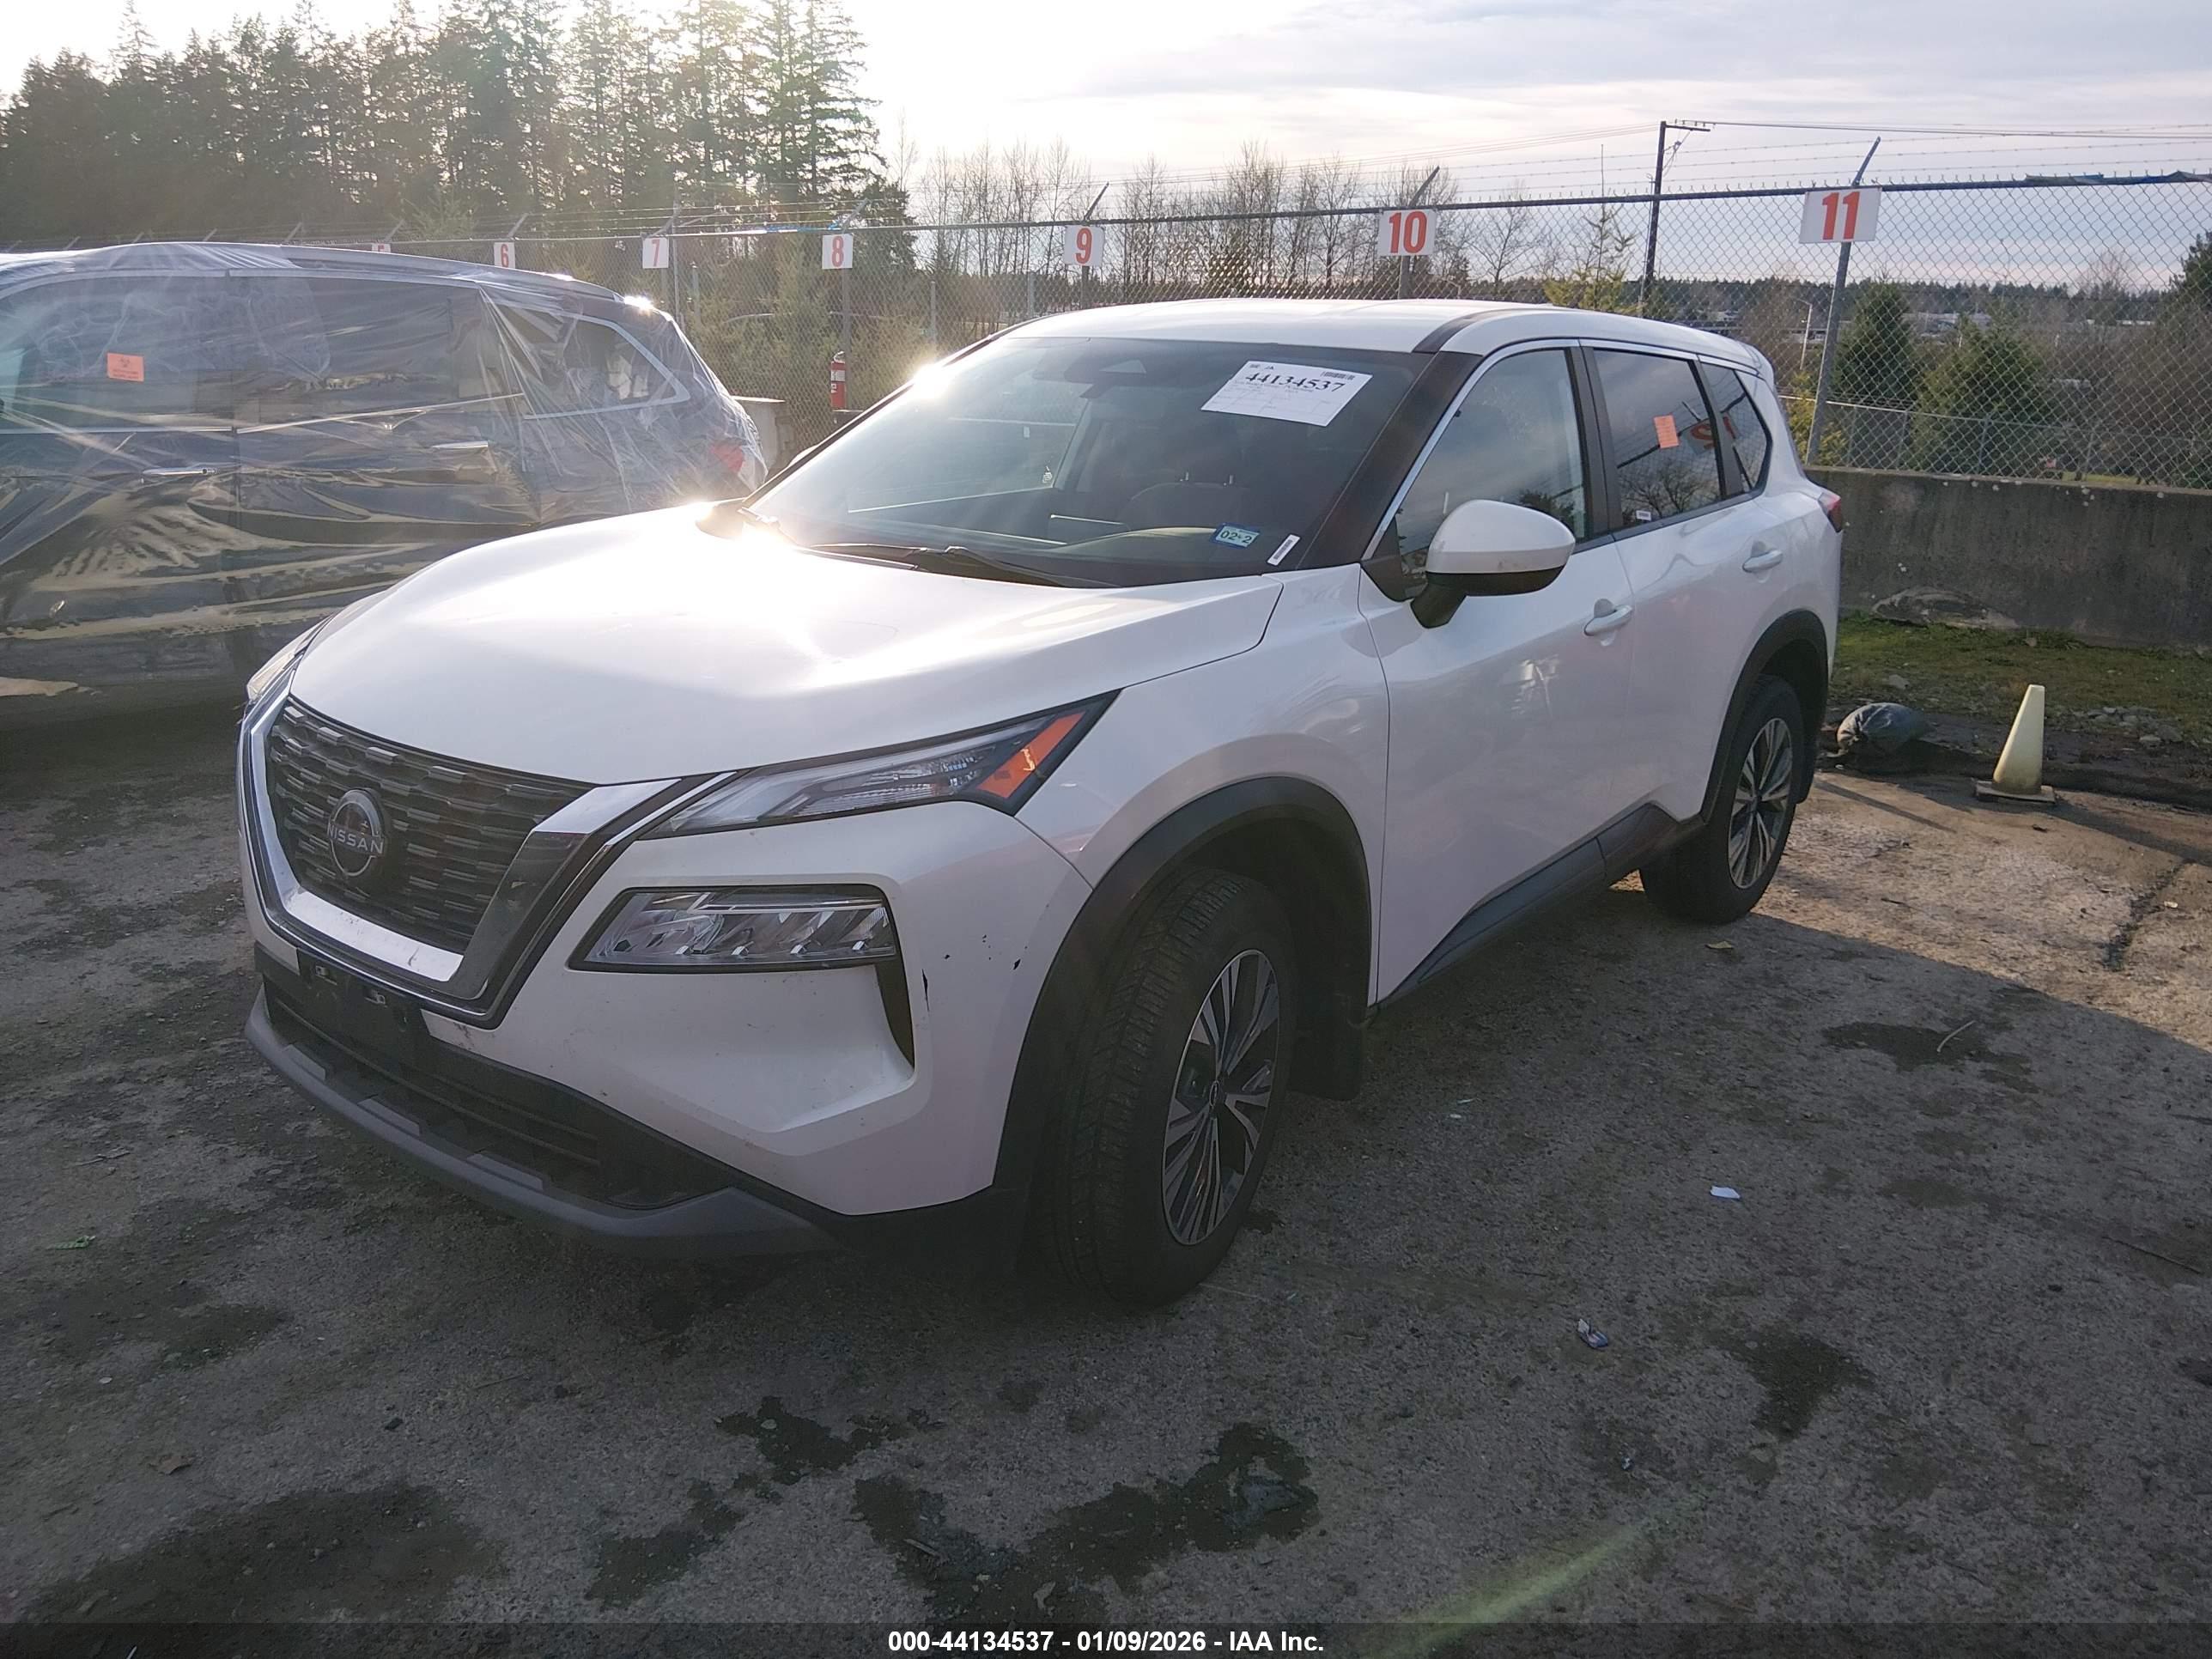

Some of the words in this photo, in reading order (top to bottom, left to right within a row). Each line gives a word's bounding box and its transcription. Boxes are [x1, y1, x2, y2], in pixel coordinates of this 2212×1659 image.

[1822, 191, 1861, 240] 11
[1075, 228, 1092, 264] 9
[1388, 211, 1428, 254] 10
[500, 243, 509, 268] 6
[651, 239, 660, 268] 7
[831, 235, 844, 268] 8
[1245, 372, 1346, 392] 44134537
[327, 822, 384, 854] NISSAN
